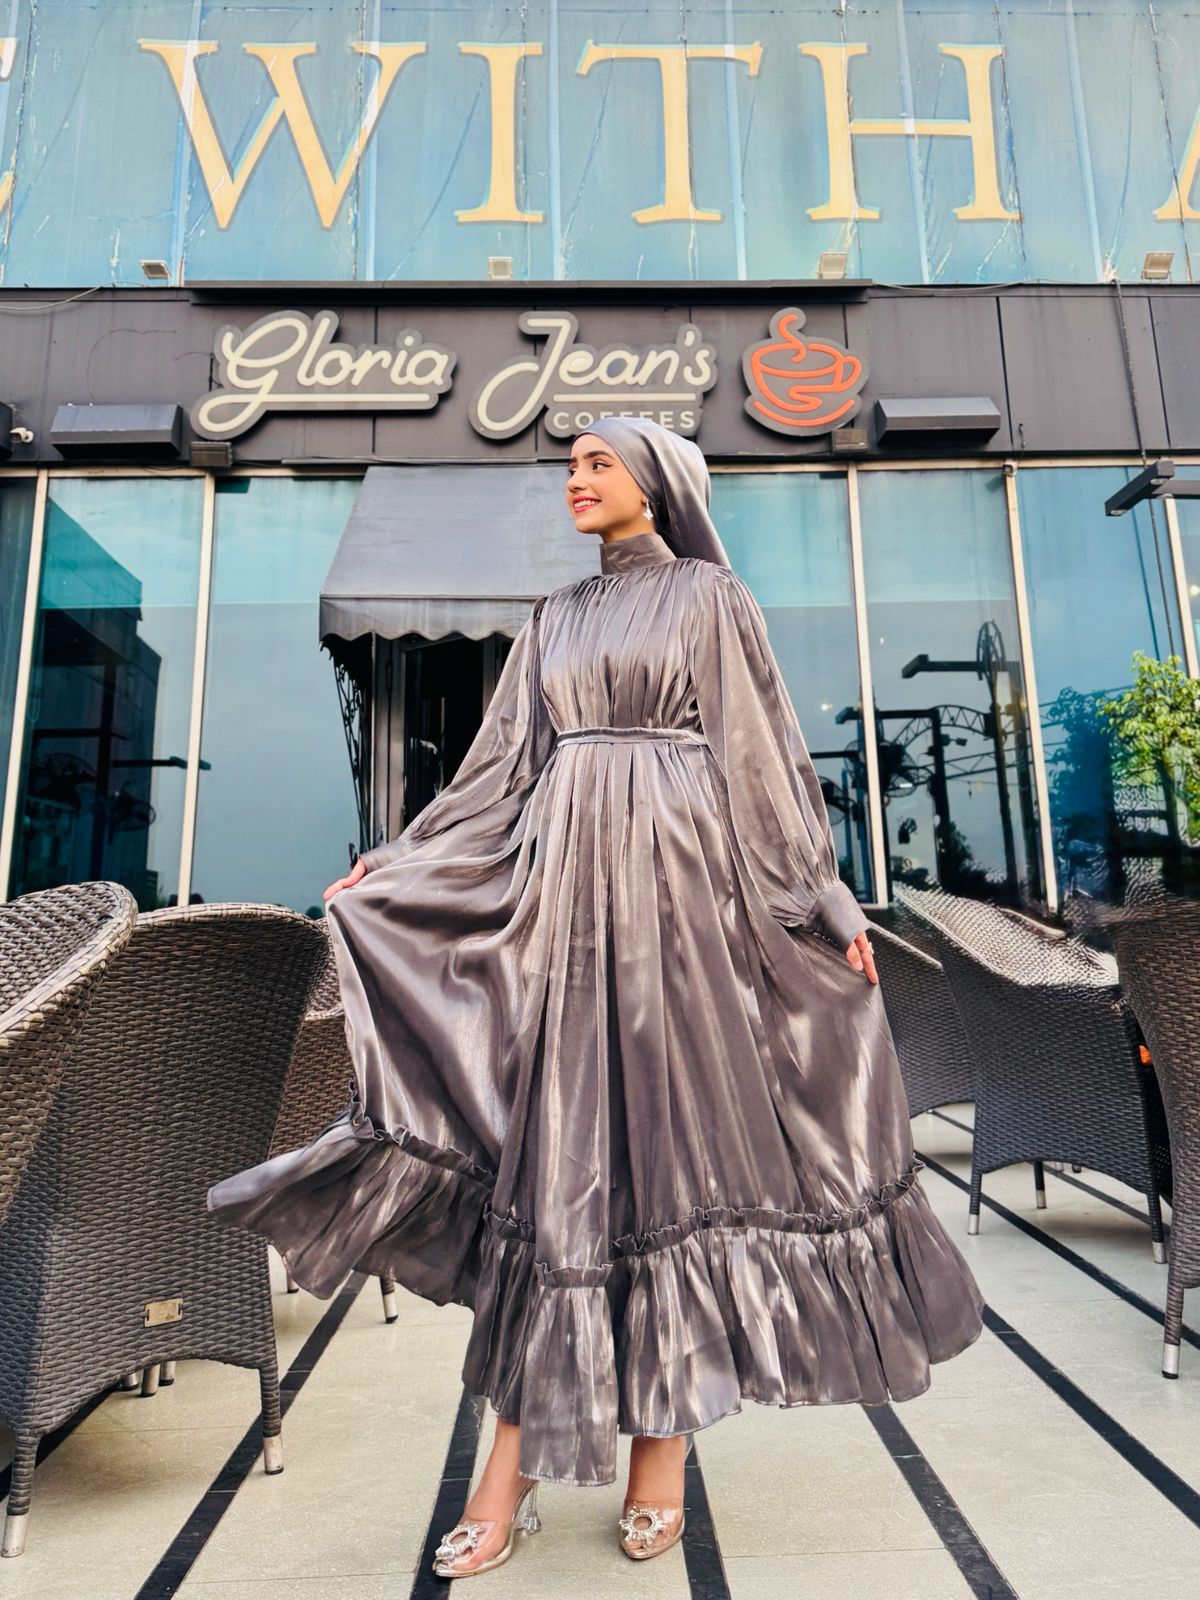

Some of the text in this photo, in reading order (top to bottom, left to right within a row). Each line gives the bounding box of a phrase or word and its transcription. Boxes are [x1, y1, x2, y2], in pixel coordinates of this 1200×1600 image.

[138, 39, 1021, 229] WITH
[198, 317, 711, 433] Gloria Jean's
